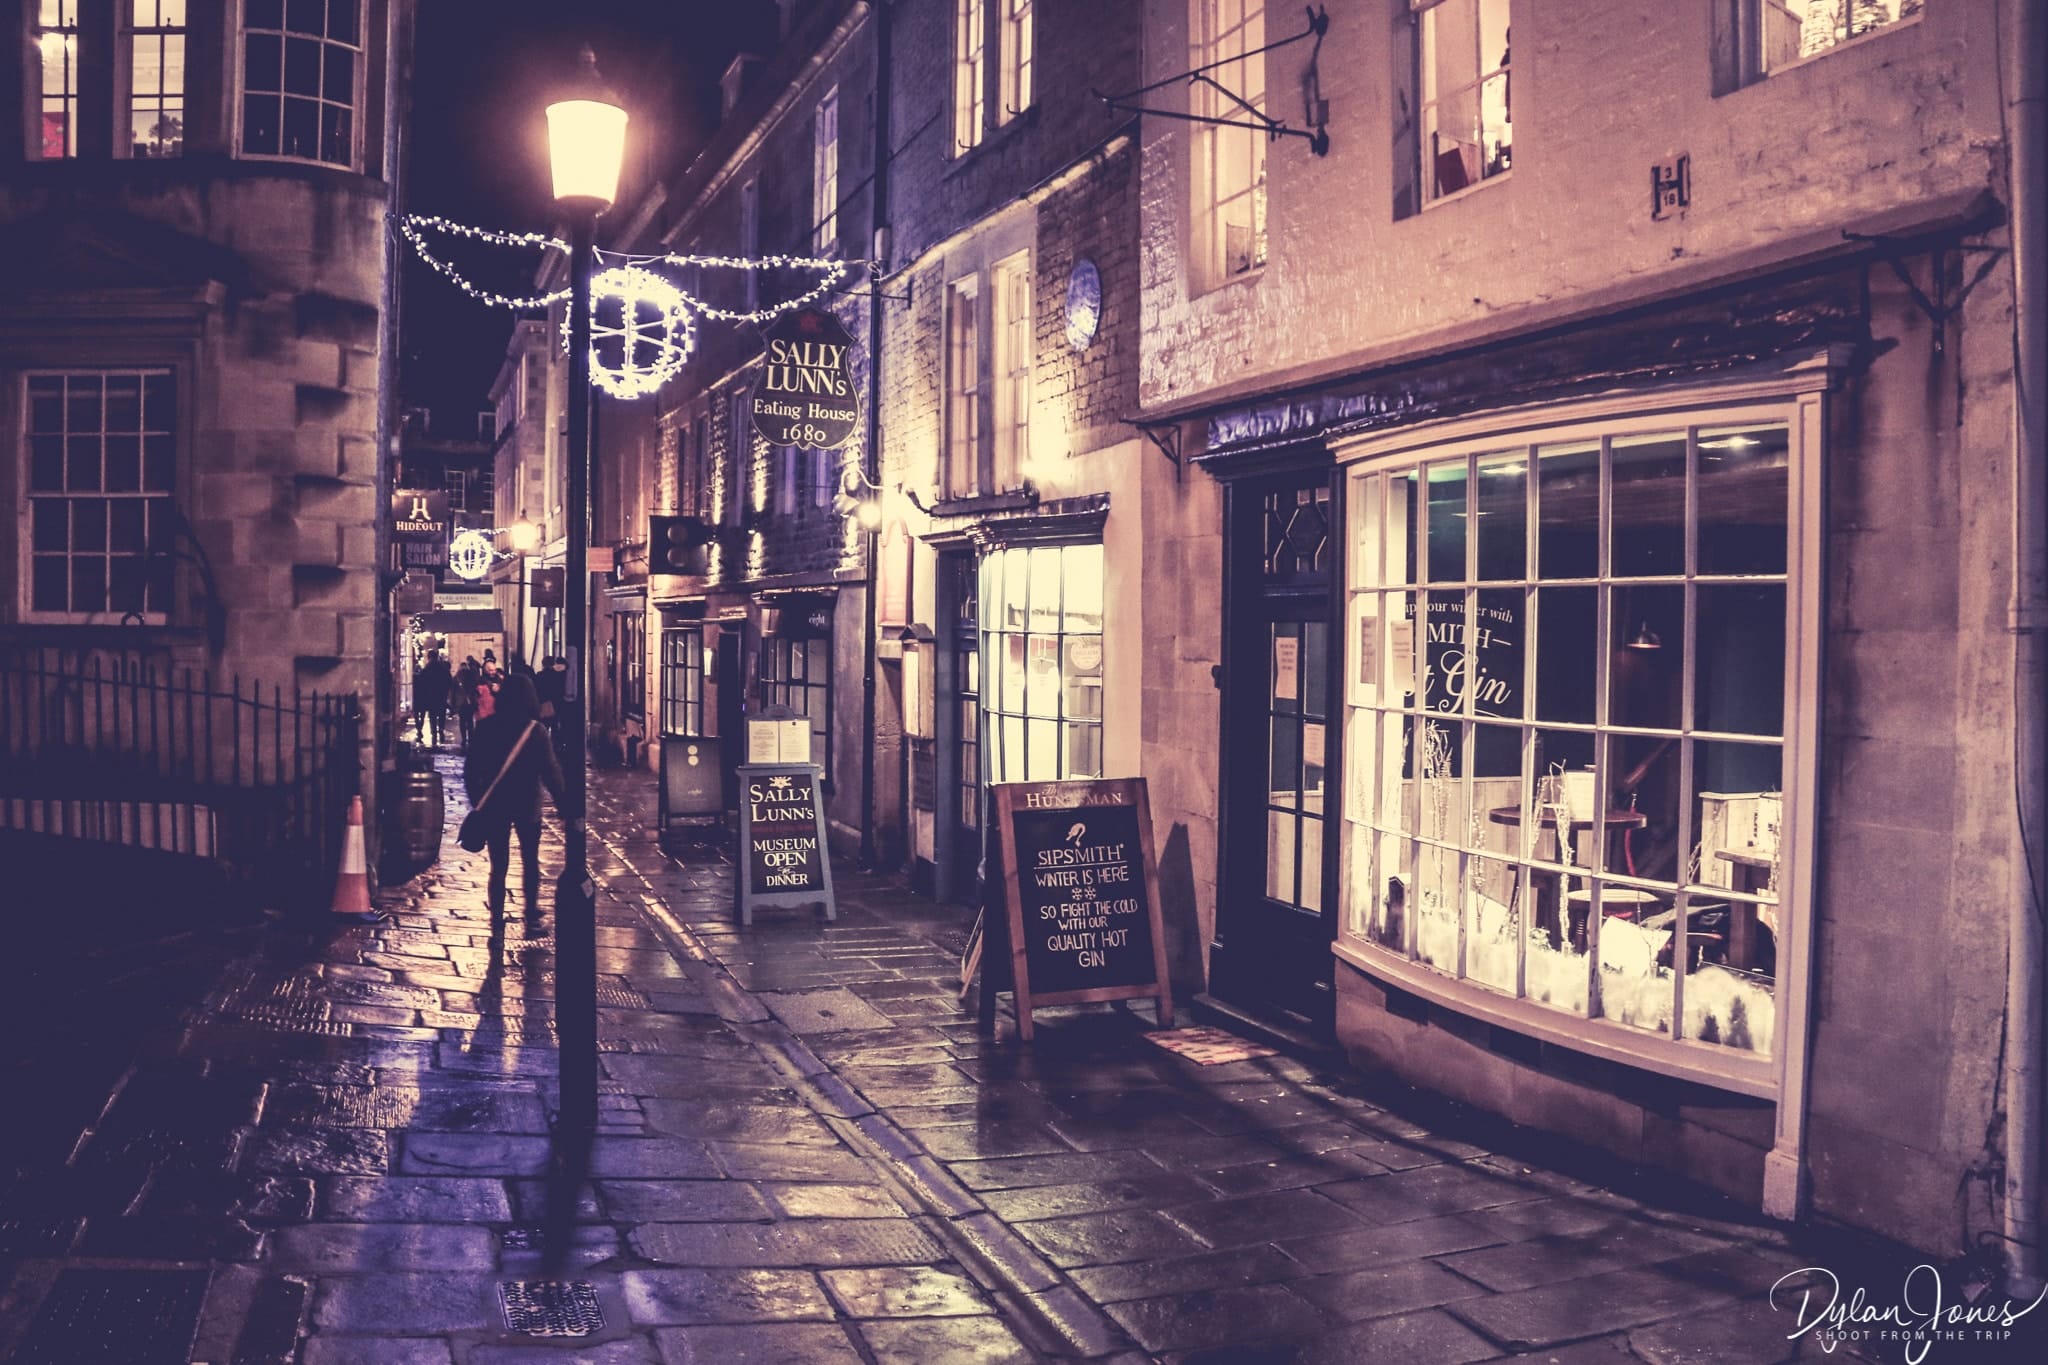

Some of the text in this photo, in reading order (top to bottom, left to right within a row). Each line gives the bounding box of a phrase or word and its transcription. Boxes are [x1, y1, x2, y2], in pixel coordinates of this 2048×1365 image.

[770, 338, 847, 370] SALLY
[753, 398, 856, 421] Eating House
[782, 423, 827, 442] 1680
[396, 520, 443, 531] HIDEOUT
[406, 543, 432, 553] HAIR
[406, 553, 441, 566] SALON
[1490, 607, 1513, 624] with
[1025, 792, 1122, 808] HUNMAN
[753, 837, 816, 852] MUSEUM
[764, 851, 808, 867] OPEN
[766, 873, 809, 887] DINNER
[1035, 866, 1129, 887] WINTER IS HERE
[1040, 899, 1138, 920] SO FIGHT THE COLD
[1058, 917, 1108, 931] WITH OUR
[1047, 929, 1128, 952] QUALITY HOT
[1078, 951, 1105, 968] GIN
